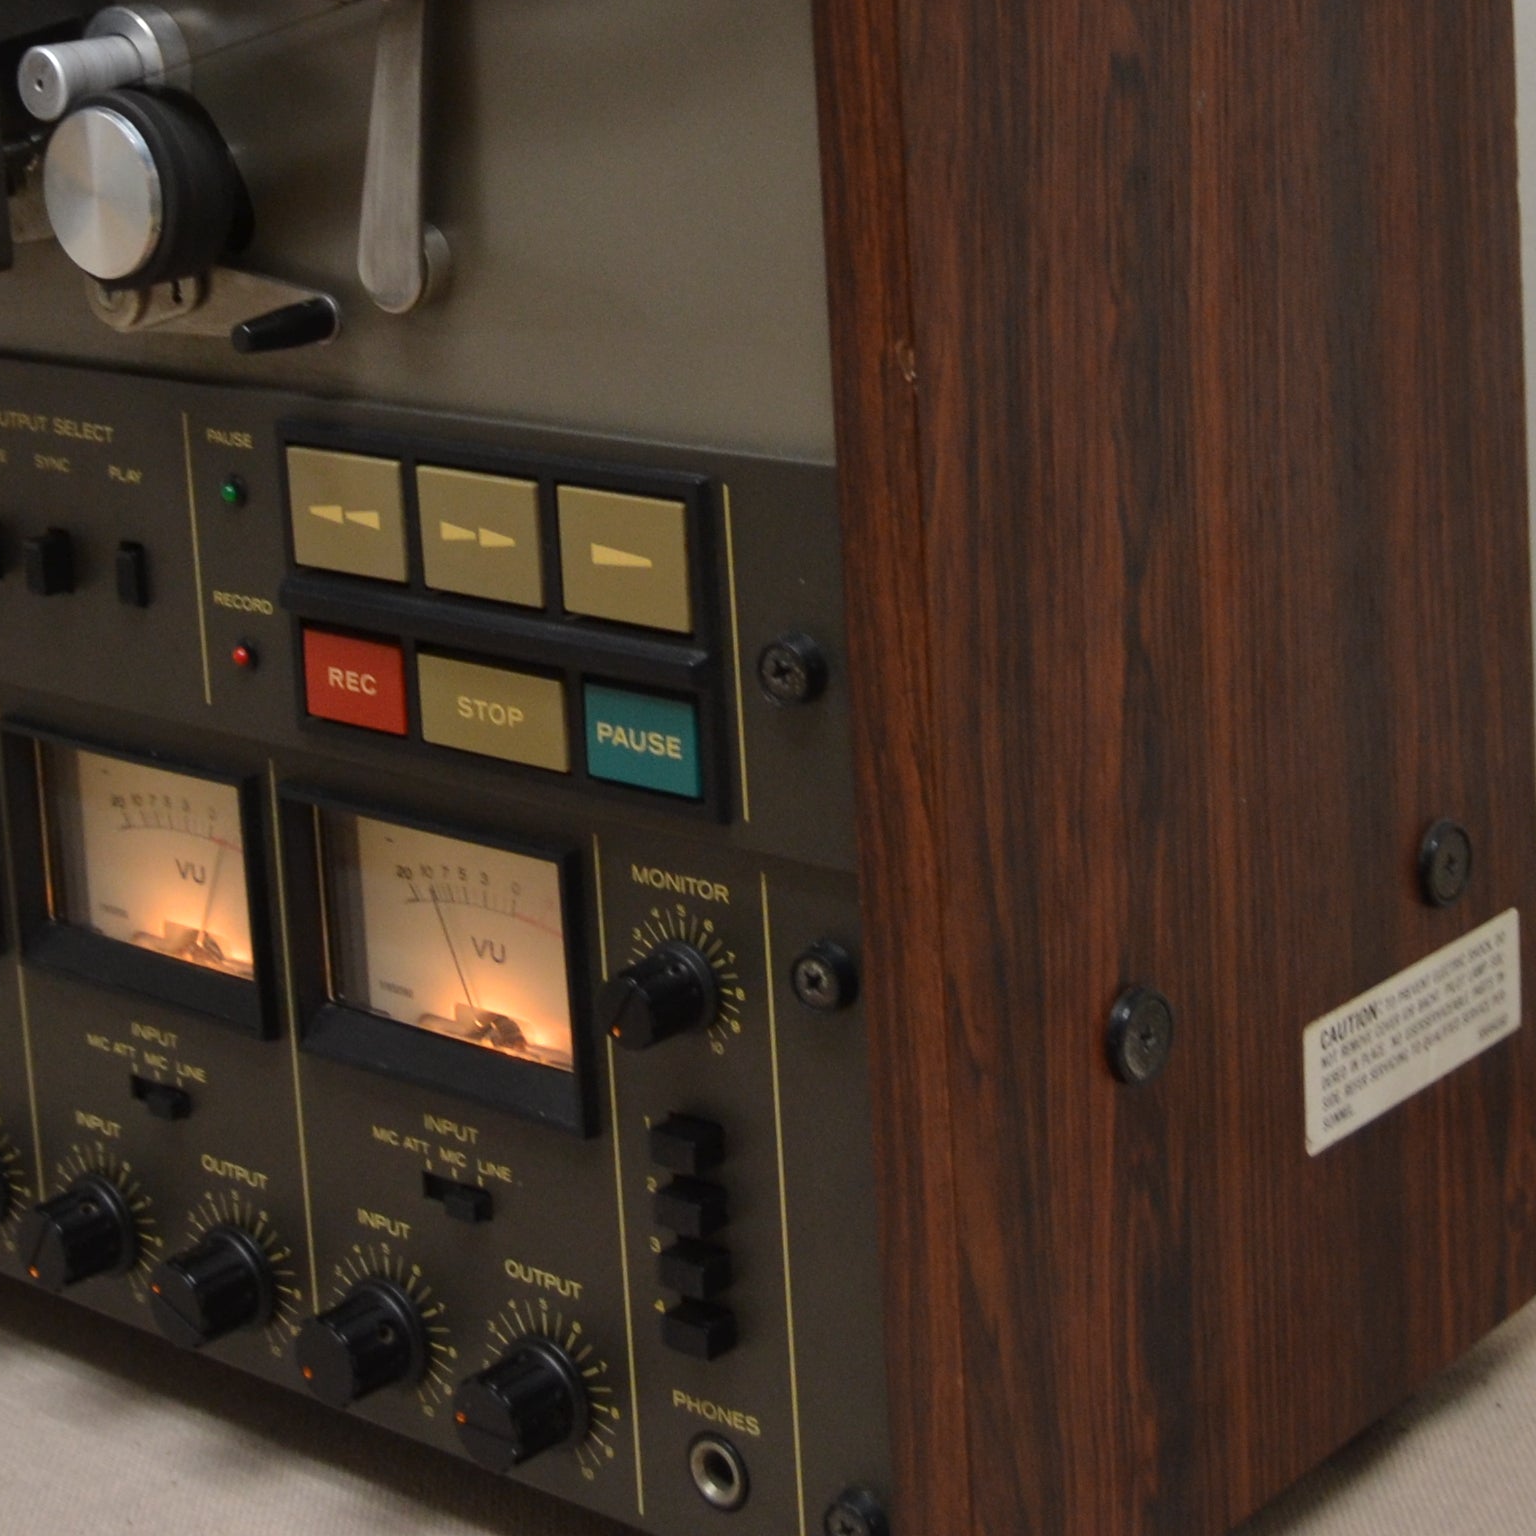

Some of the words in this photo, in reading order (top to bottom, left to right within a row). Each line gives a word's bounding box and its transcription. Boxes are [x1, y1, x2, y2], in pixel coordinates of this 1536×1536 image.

[52, 417, 114, 443] SELECT
[206, 427, 253, 449] PAUSE
[213, 589, 273, 615] RECORD
[328, 666, 378, 696] REC
[457, 696, 524, 729] STOP
[596, 720, 683, 760] PAUSE
[175, 858, 206, 885] VU
[631, 864, 731, 905] MONITOR
[470, 935, 507, 965] VU
[423, 1113, 480, 1146] INPUT
[372, 1124, 401, 1147] MIC
[439, 1145, 467, 1169] MIC
[476, 1158, 514, 1184] LINE
[201, 1153, 269, 1190] OUTPUT
[357, 1207, 413, 1240] INPUT
[504, 1258, 584, 1301] OUTPUT
[672, 1388, 761, 1437] PHONES
